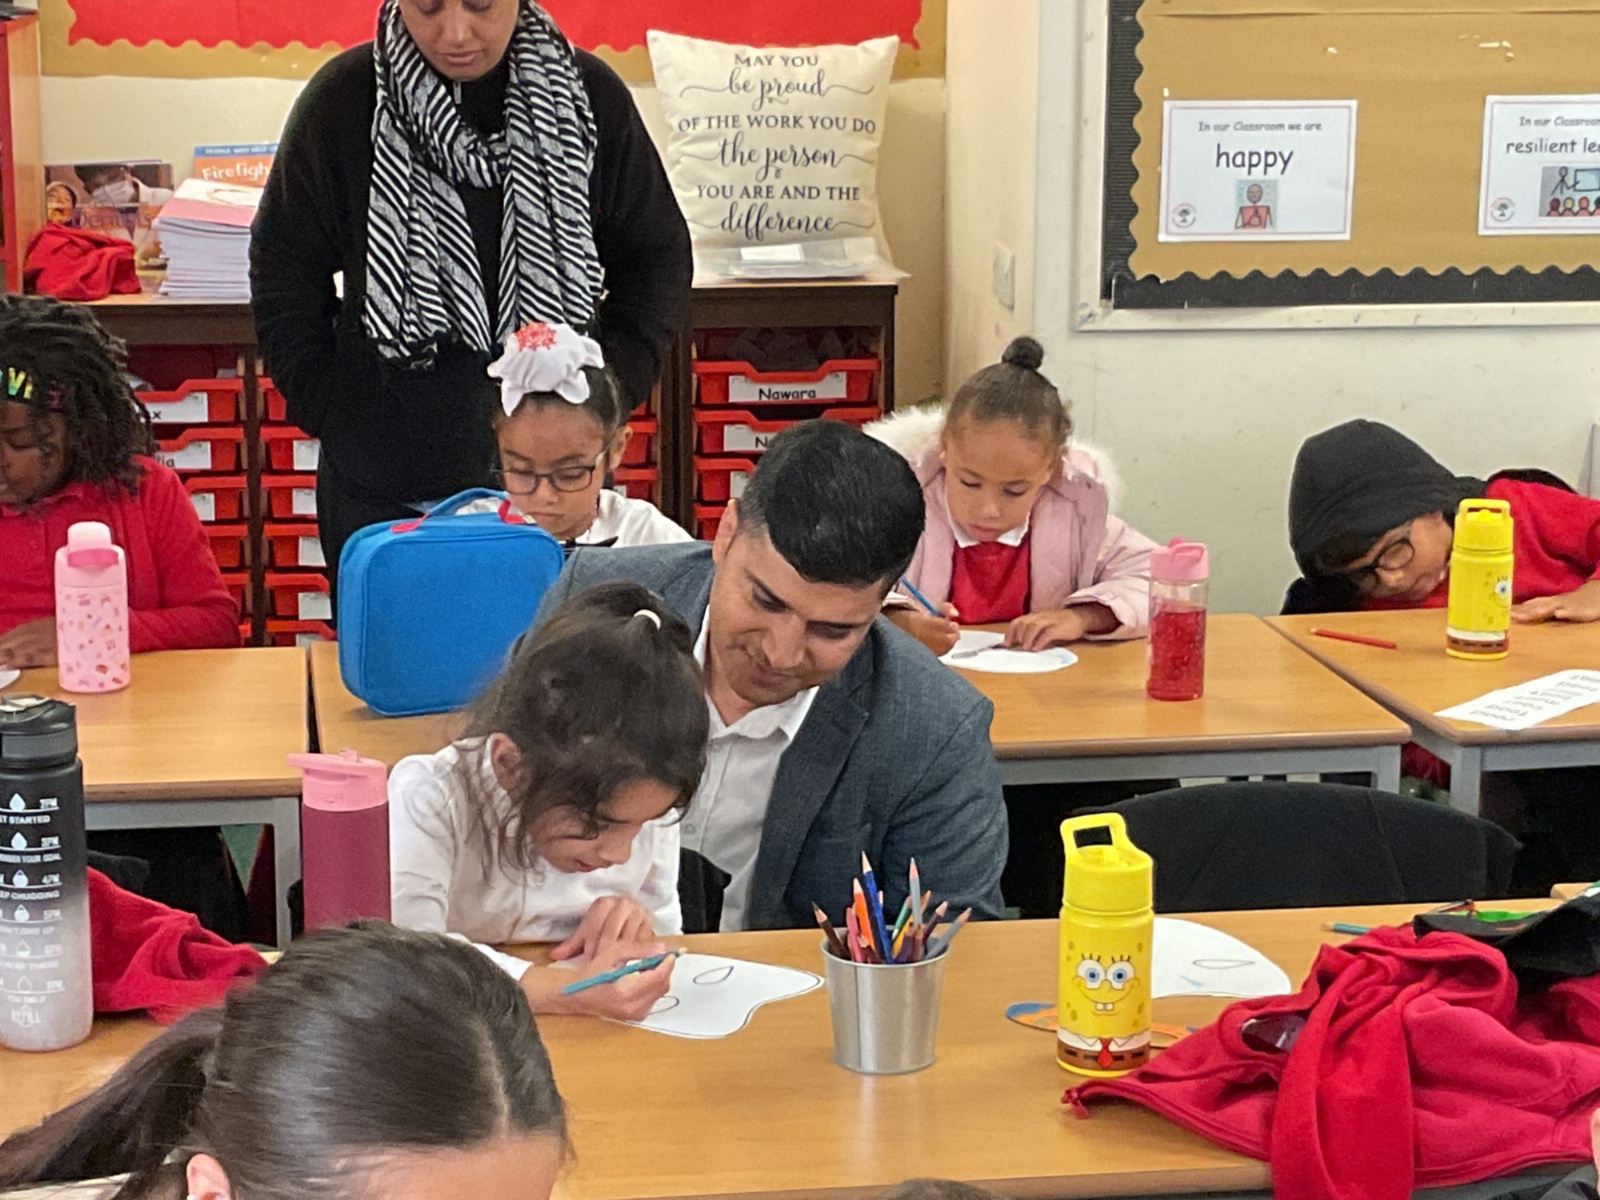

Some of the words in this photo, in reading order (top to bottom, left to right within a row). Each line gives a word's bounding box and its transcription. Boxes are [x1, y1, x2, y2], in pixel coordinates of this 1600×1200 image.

[734, 54, 774, 67] MAY
[780, 55, 819, 67] YOU
[752, 69, 828, 111] proud
[678, 117, 700, 132] OF
[704, 115, 741, 129] THE
[747, 115, 804, 129] WORK
[809, 116, 847, 130] YOU
[852, 118, 876, 134] DO
[1198, 121, 1210, 132] In
[1213, 123, 1230, 132] our
[1233, 122, 1285, 132] Classroom
[1288, 123, 1301, 131] we
[1304, 123, 1322, 131] are
[1519, 116, 1531, 127] In
[1534, 118, 1551, 127] our
[1506, 137, 1577, 154] resilient
[1583, 137, 1600, 153] le
[720, 131, 759, 167] the
[755, 145, 839, 182] person
[1216, 143, 1294, 175] happy
[202, 162, 270, 181] Firefigh
[697, 185, 733, 198] YOU
[739, 185, 774, 199] ARE
[780, 186, 820, 199] AND
[826, 186, 860, 200] THE
[721, 202, 836, 241] difference
[759, 387, 816, 400] Nawara
[9, 815, 50, 824] STARTED
